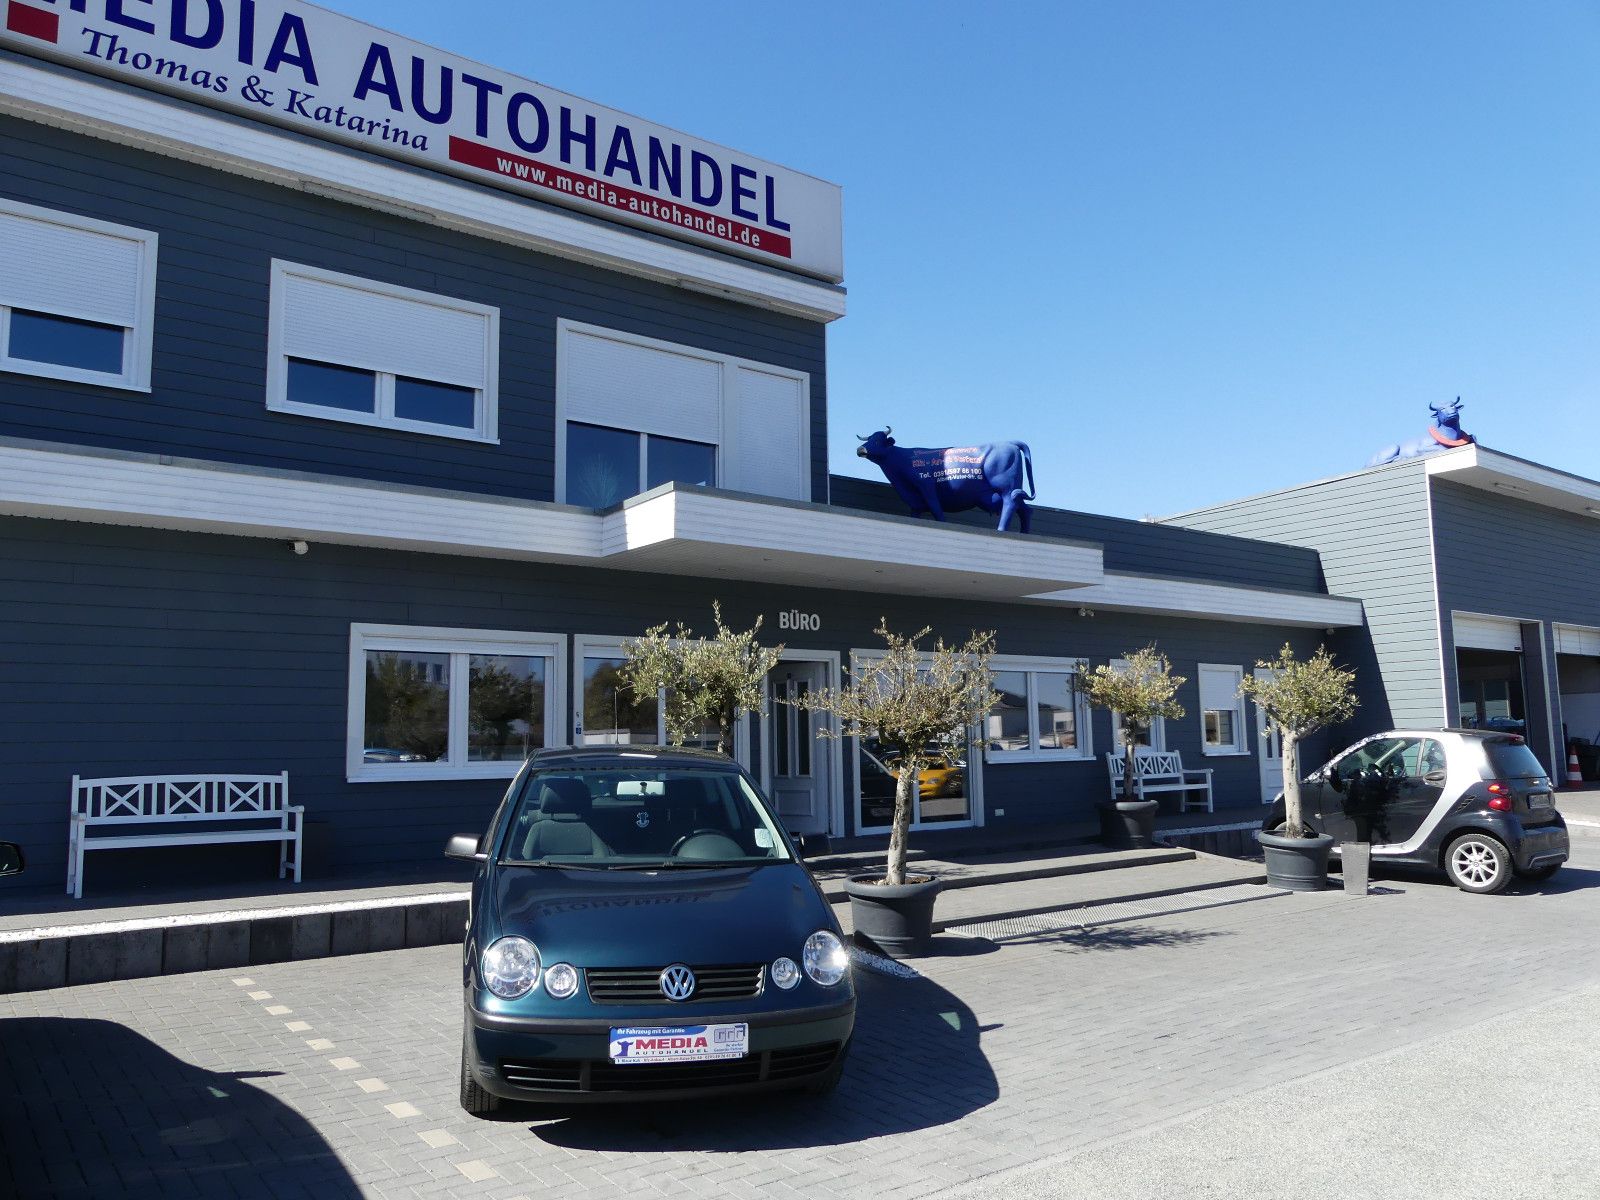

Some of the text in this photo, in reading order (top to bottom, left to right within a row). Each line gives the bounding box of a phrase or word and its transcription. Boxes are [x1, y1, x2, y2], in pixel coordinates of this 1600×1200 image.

[37, 0, 790, 232] DIA AUTOHANDEL
[81, 27, 429, 151] Thomas & Katarina
[497, 157, 761, 247] www.media-autohandel.de
[779, 610, 820, 631] BÜRO
[660, 963, 695, 1000] VW
[636, 1037, 708, 1050] MEDIA
